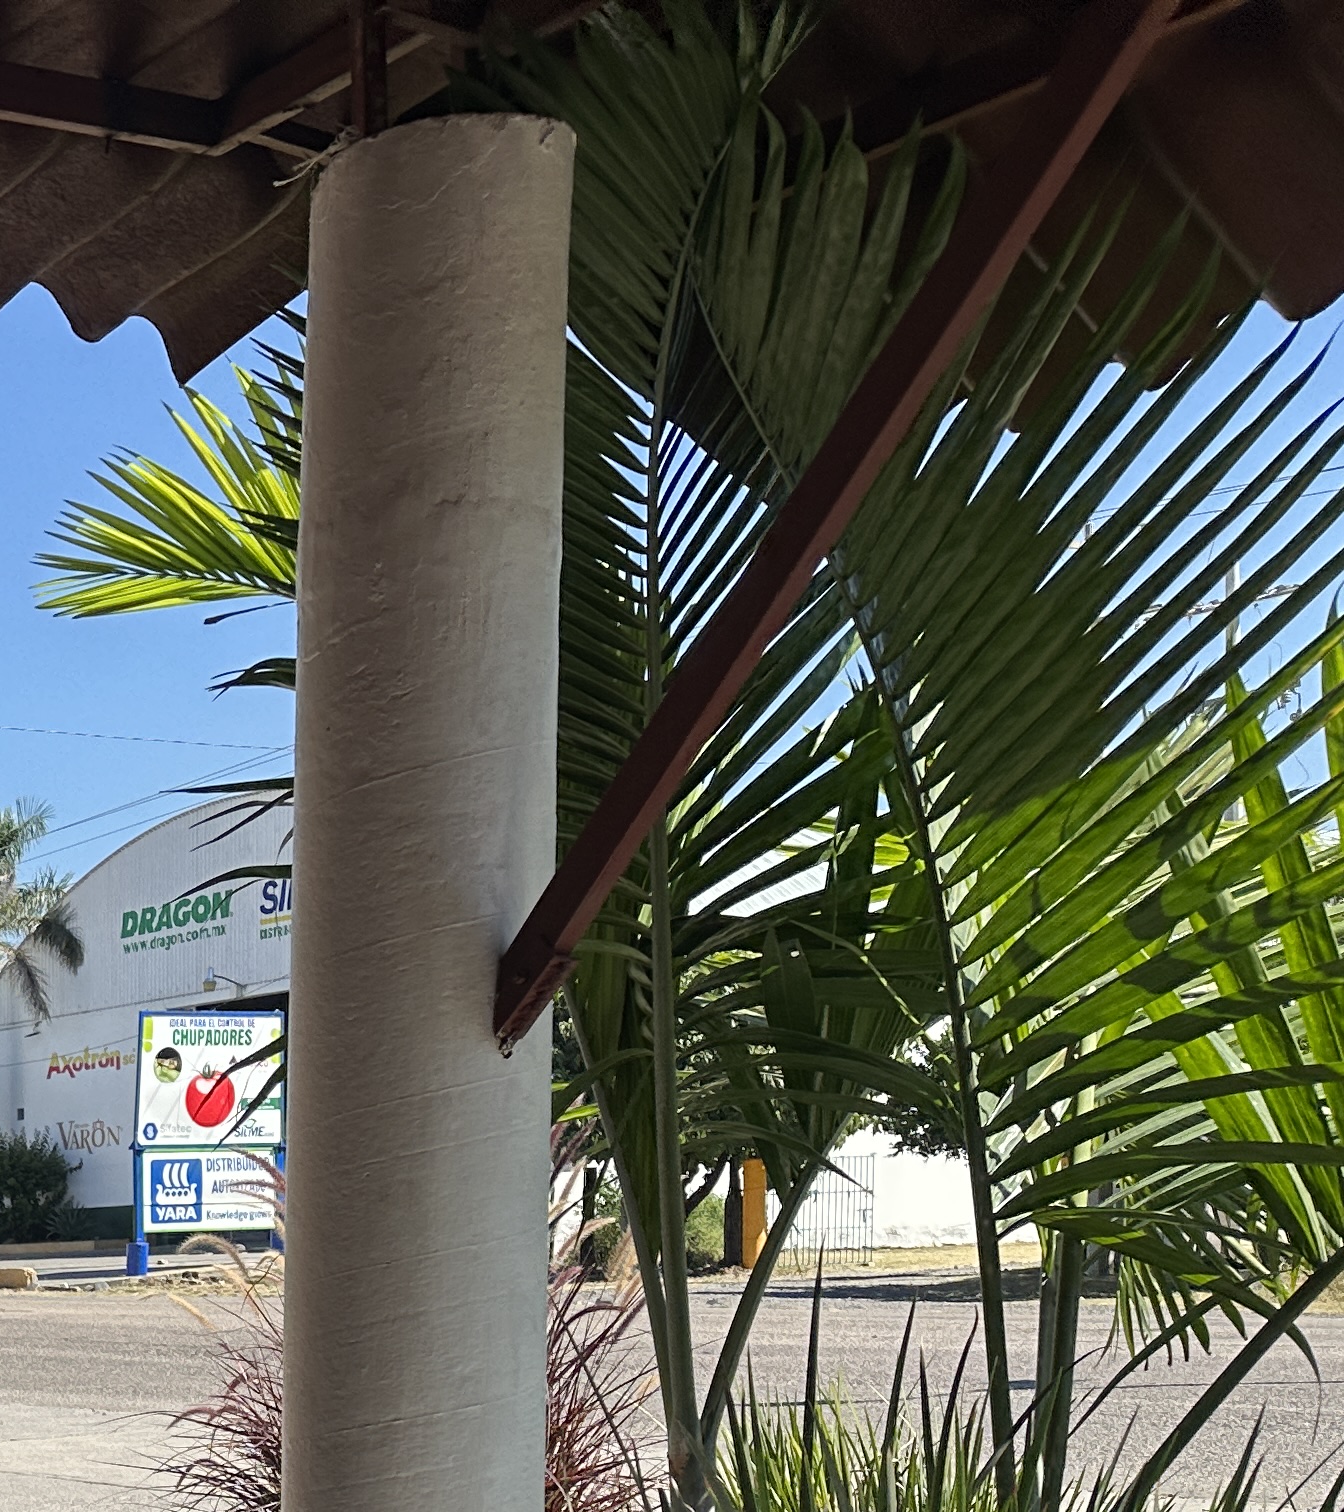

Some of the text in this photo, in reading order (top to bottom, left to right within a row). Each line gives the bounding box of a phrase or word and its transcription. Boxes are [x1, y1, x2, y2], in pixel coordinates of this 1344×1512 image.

[120, 889, 233, 939] DRAGON
[123, 924, 227, 954] www.dragon.com.mx
[189, 1018, 207, 1028] PARA
[208, 1018, 216, 1028] EL
[217, 1018, 245, 1028] CONTROL
[247, 1018, 256, 1028] DE
[172, 1028, 253, 1047] CHUPADORES
[46, 1046, 121, 1079] Axotrón
[155, 1205, 198, 1221] YARA
